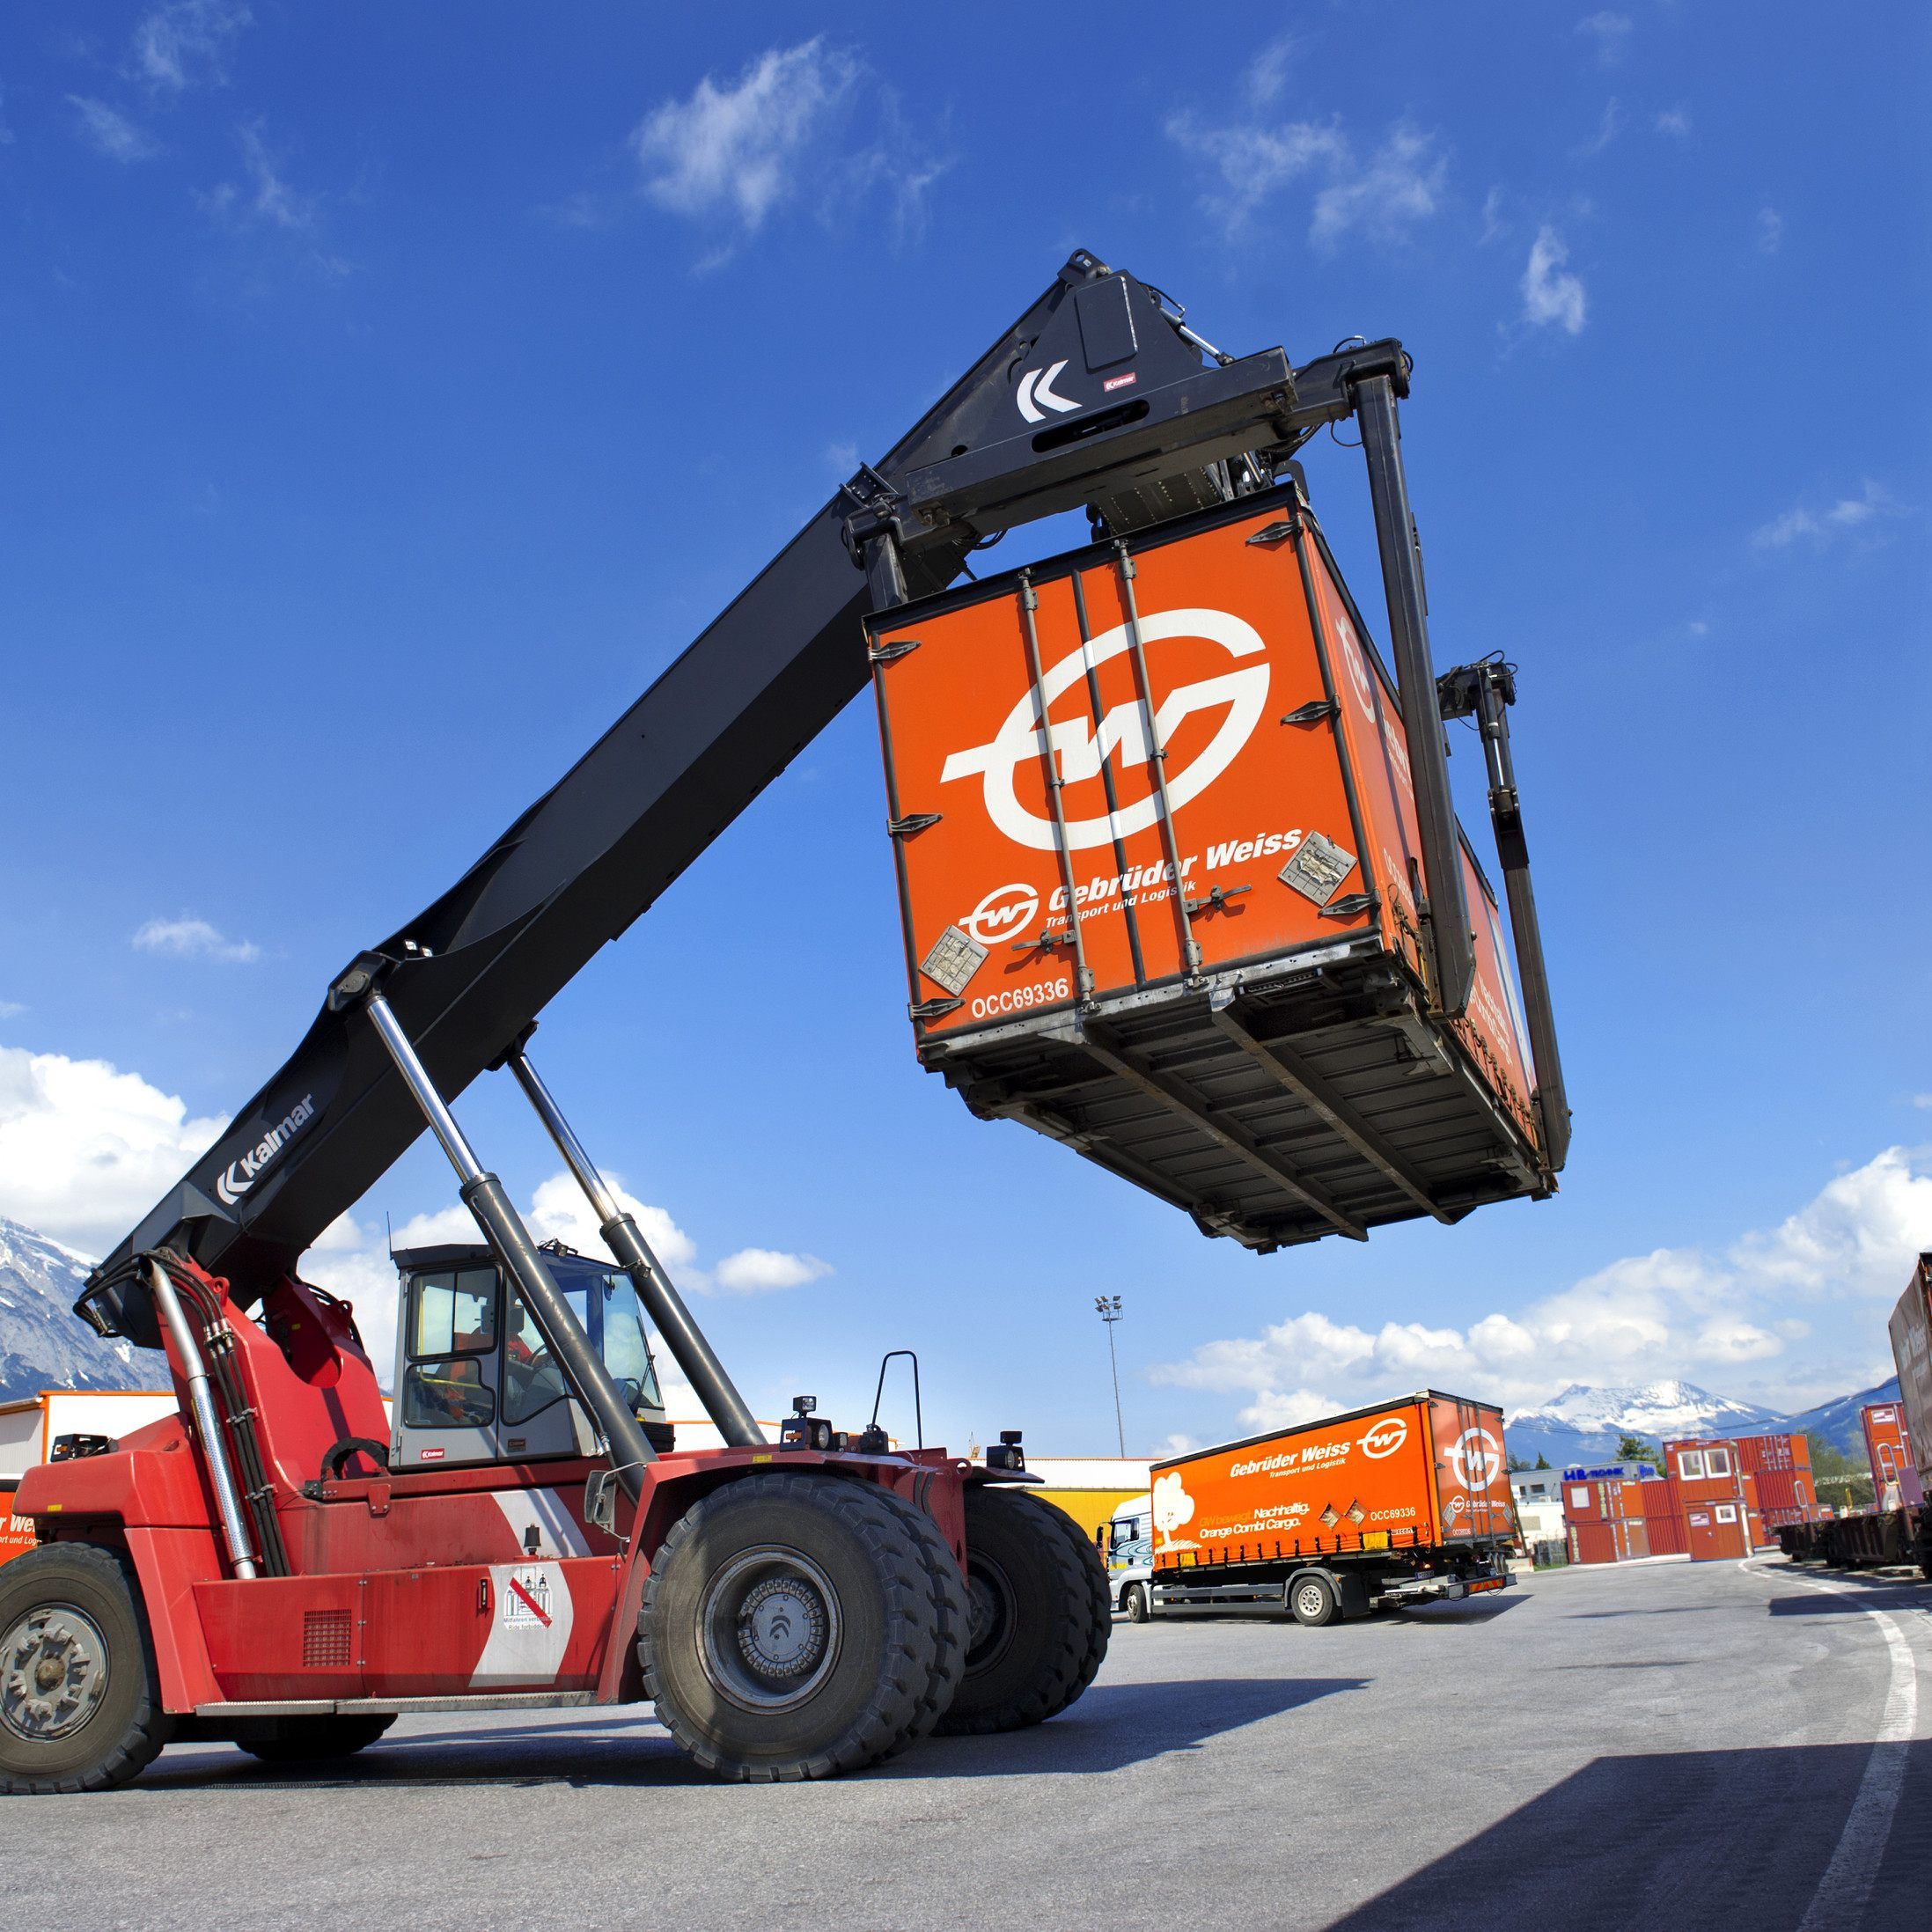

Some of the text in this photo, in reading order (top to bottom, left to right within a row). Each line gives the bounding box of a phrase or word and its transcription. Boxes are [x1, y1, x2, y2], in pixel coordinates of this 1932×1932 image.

[1048, 828, 1303, 912] Gebrüder Weiss
[1112, 894, 1138, 912] und
[1141, 880, 1197, 904] Logisik
[972, 977, 1069, 1018] OCC69336
[239, 1092, 315, 1179] Kalmar
[1230, 1440, 1351, 1478] Gebrüder Weiss
[1269, 1457, 1347, 1479] Transport und Logistik
[1253, 1502, 1310, 1519] Nachhaltig.
[1370, 1506, 1416, 1522] OCC69336
[9, 1535, 24, 1545] und
[1199, 1517, 1301, 1539] Orange Combi Cargo.
